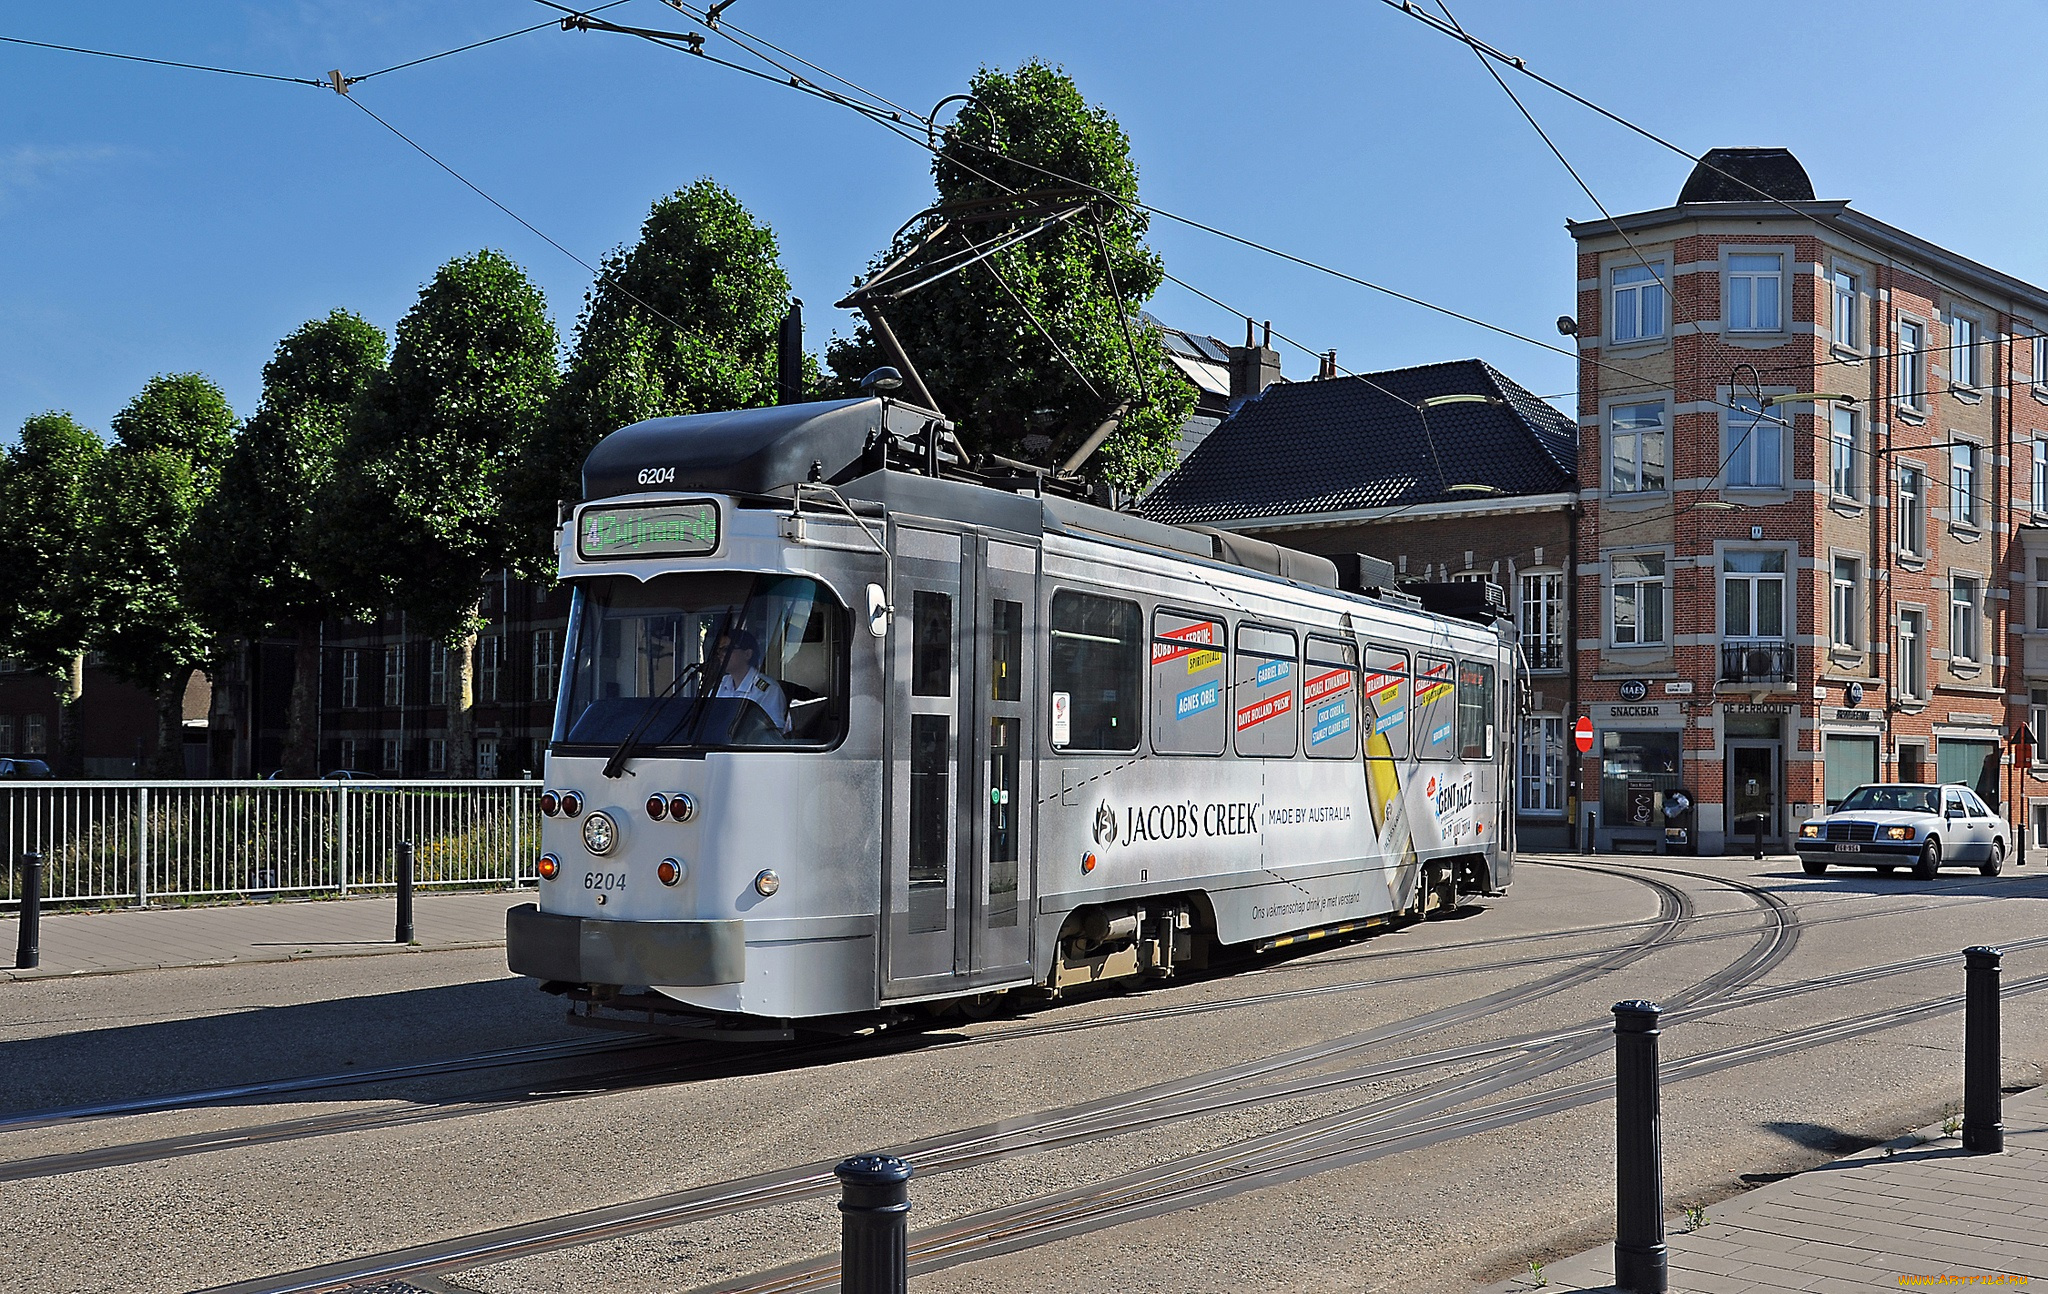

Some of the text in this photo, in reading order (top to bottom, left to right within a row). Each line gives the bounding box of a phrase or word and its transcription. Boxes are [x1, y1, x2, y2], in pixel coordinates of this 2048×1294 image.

[637, 467, 675, 485] 6204
[603, 511, 717, 549] Zwijnaarde
[1258, 665, 1277, 683] GABRIEL
[1622, 686, 1646, 695] MAES
[1178, 687, 1216, 714] AGNES OBEL
[1723, 704, 1794, 716] DE PERROQUET
[1238, 710, 1250, 728] DAVE
[1251, 701, 1272, 721] HOLLAND
[1610, 706, 1659, 717] SNACKBAR
[1438, 781, 1473, 816] GENT JAZZ
[1122, 800, 1258, 847] JACOB'S CREEK
[1268, 806, 1351, 825] MADE BY AUSTRALIA
[583, 872, 626, 891] 6204
[1252, 904, 1266, 920] Ons
[1266, 901, 1305, 919] vakmanschap
[1305, 898, 1320, 914] drink
[1320, 898, 1327, 913] je
[1327, 897, 1338, 911] met
